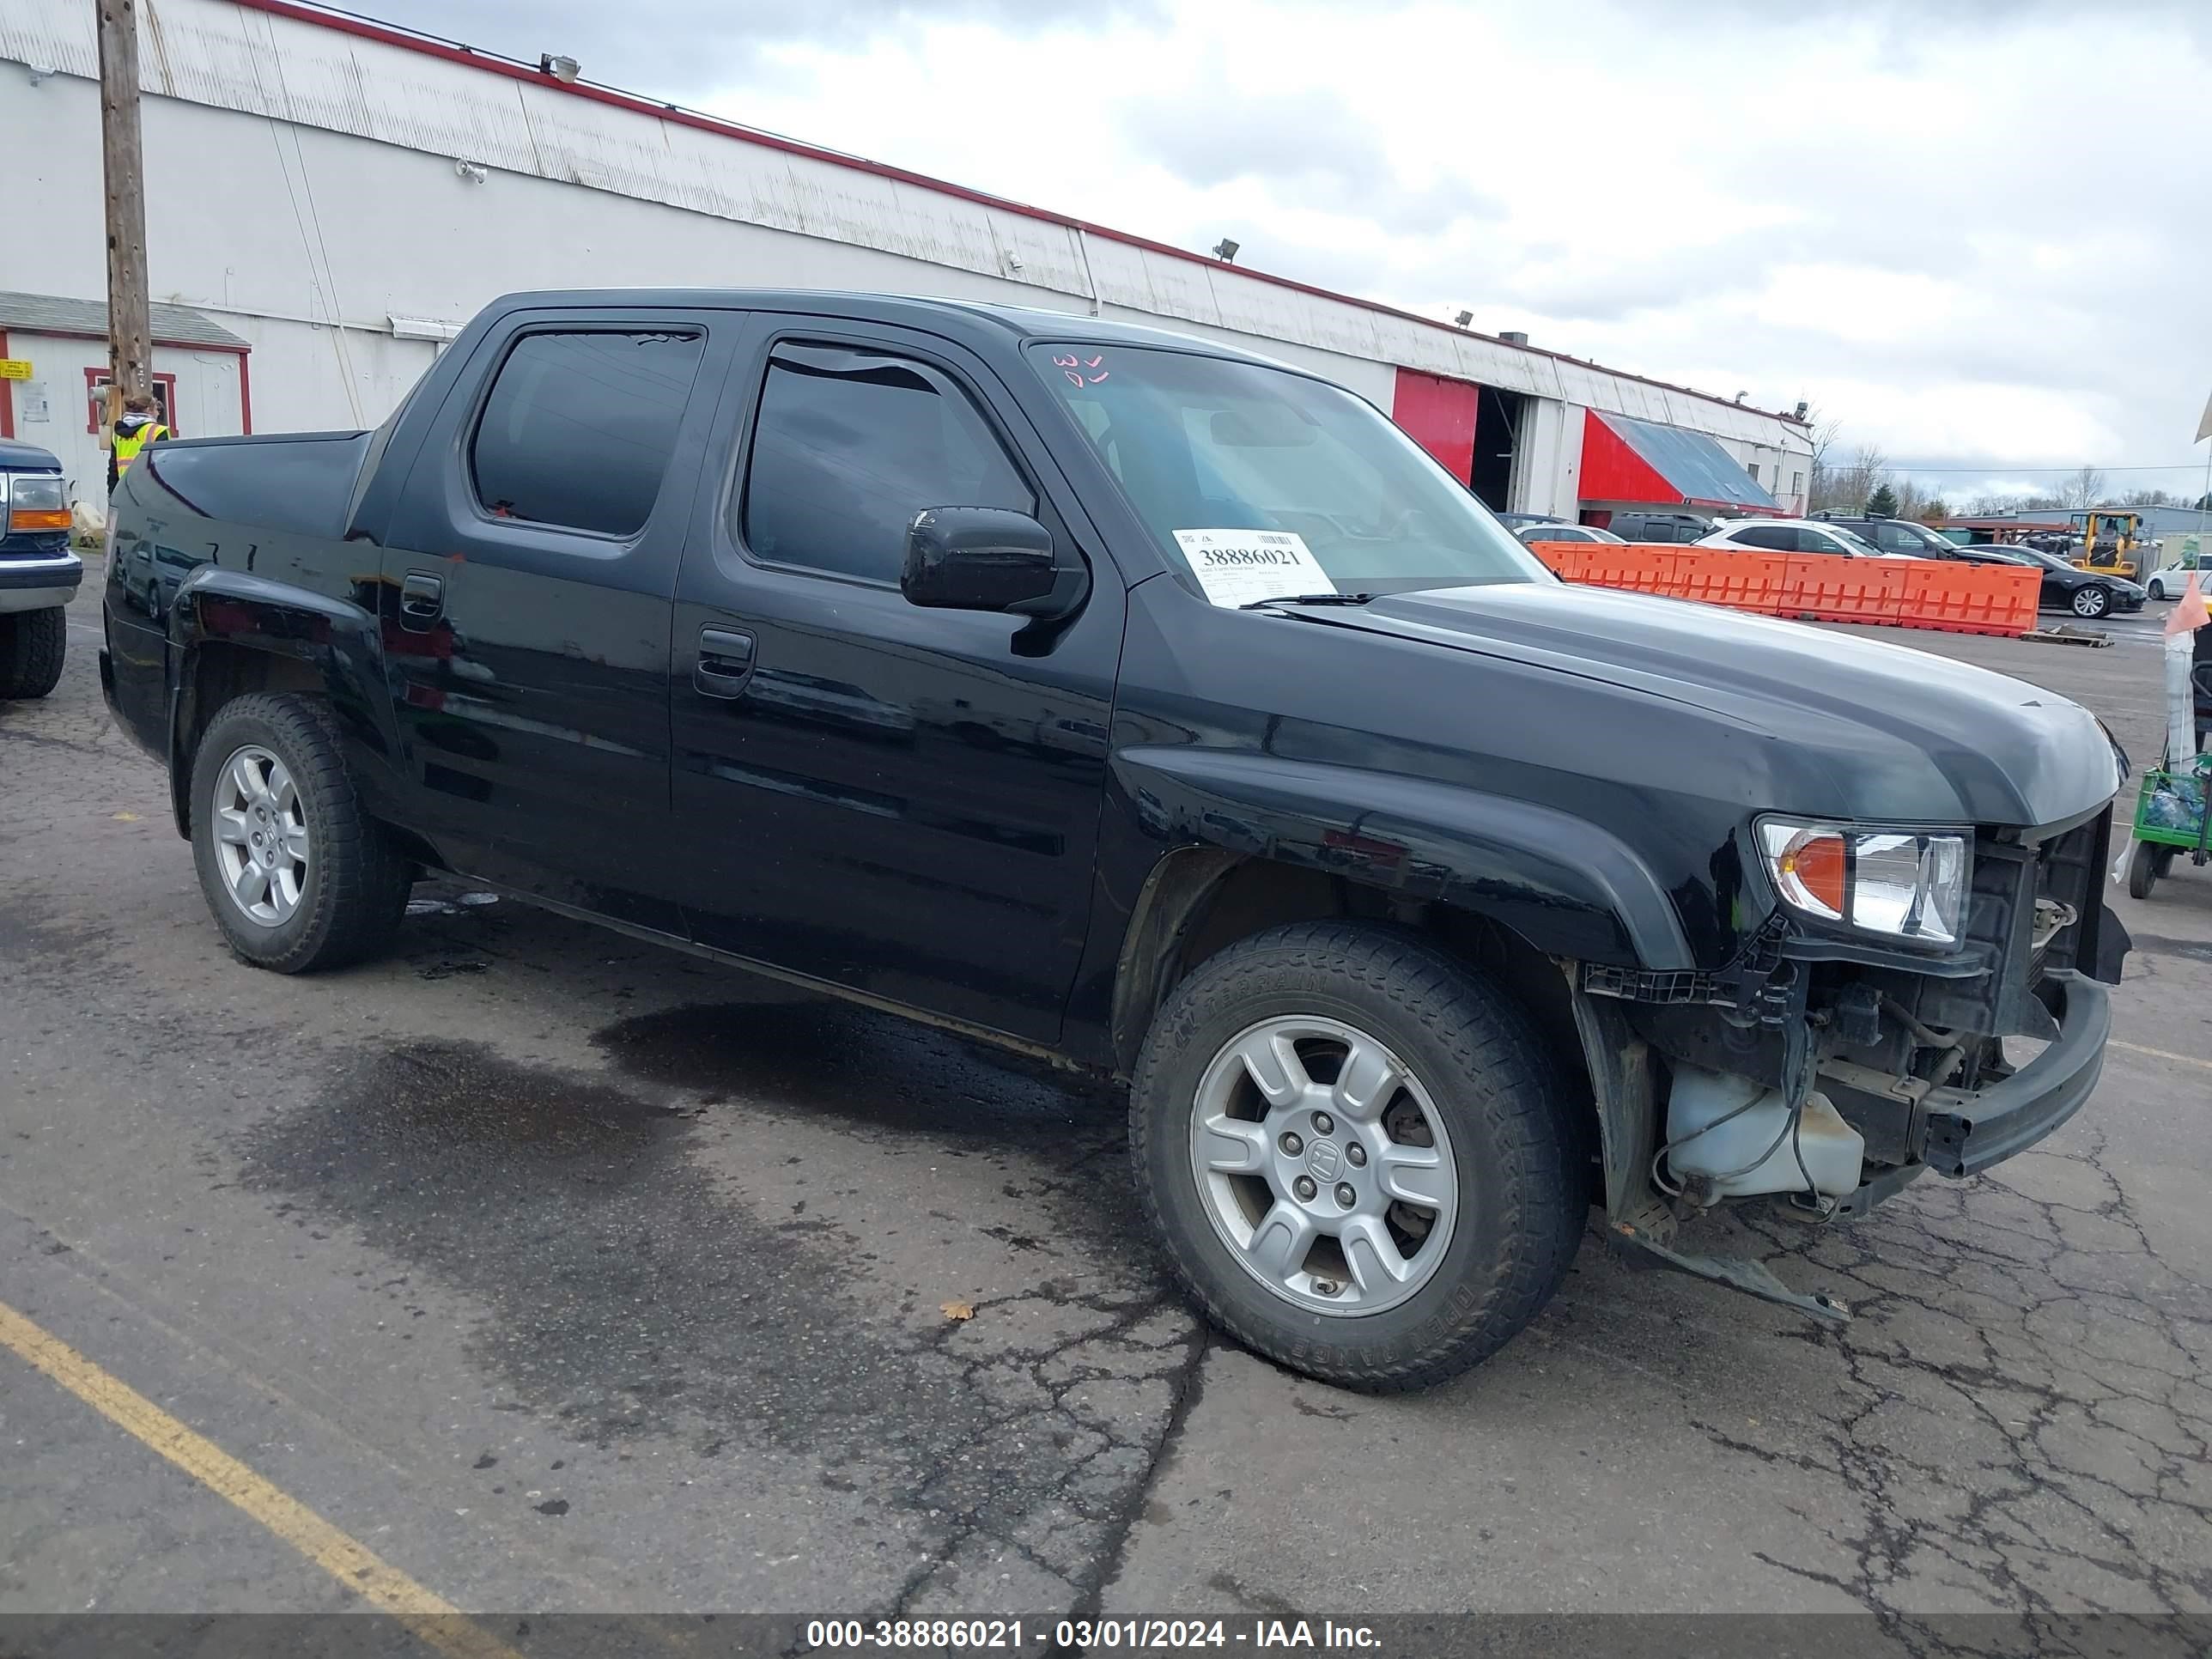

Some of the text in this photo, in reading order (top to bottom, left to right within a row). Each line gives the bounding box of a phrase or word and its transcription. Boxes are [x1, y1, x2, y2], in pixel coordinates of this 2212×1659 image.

[1199, 548, 1301, 567] 38886021
[1203, 971, 1328, 1018] TERRAIN
[1291, 1285, 1476, 1368] OPEN RANGE
